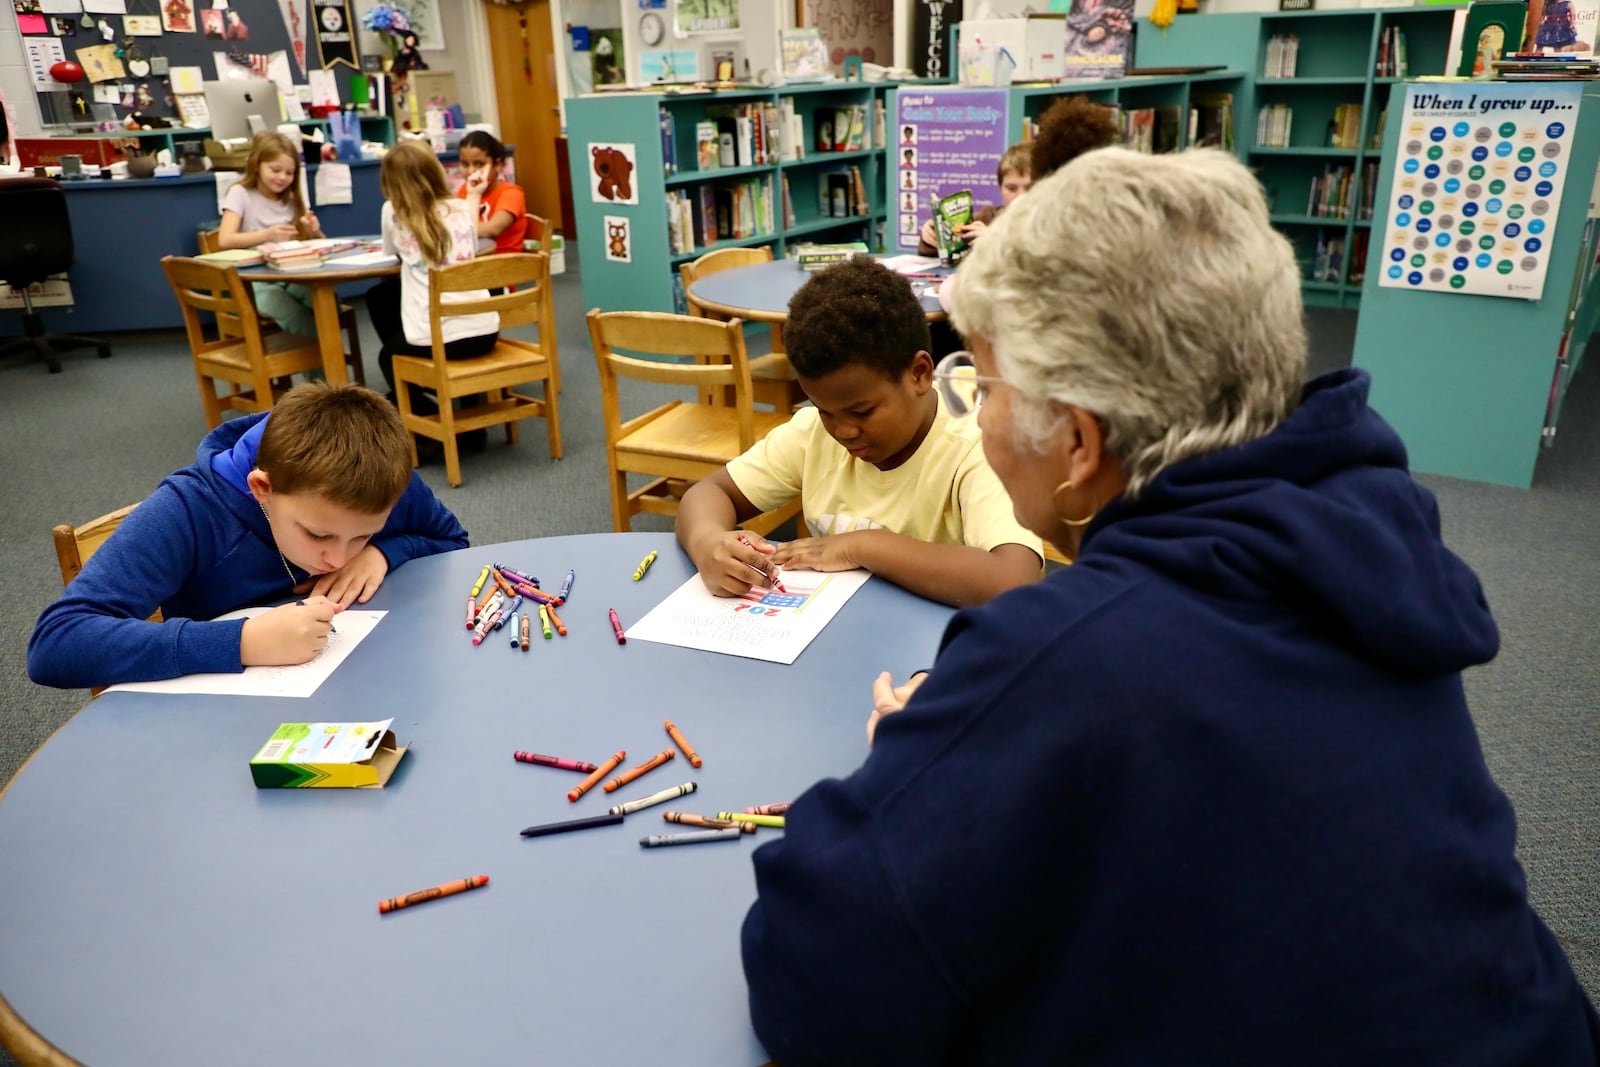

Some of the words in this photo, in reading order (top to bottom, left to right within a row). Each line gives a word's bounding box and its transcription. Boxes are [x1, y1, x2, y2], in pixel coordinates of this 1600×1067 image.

[1412, 94, 1463, 110] When
[1468, 94, 1477, 109] I
[1480, 99, 1526, 114] grow
[1530, 99, 1573, 114] up...
[903, 106, 934, 121] Calm
[936, 106, 963, 121] Your
[967, 105, 1000, 126] Body
